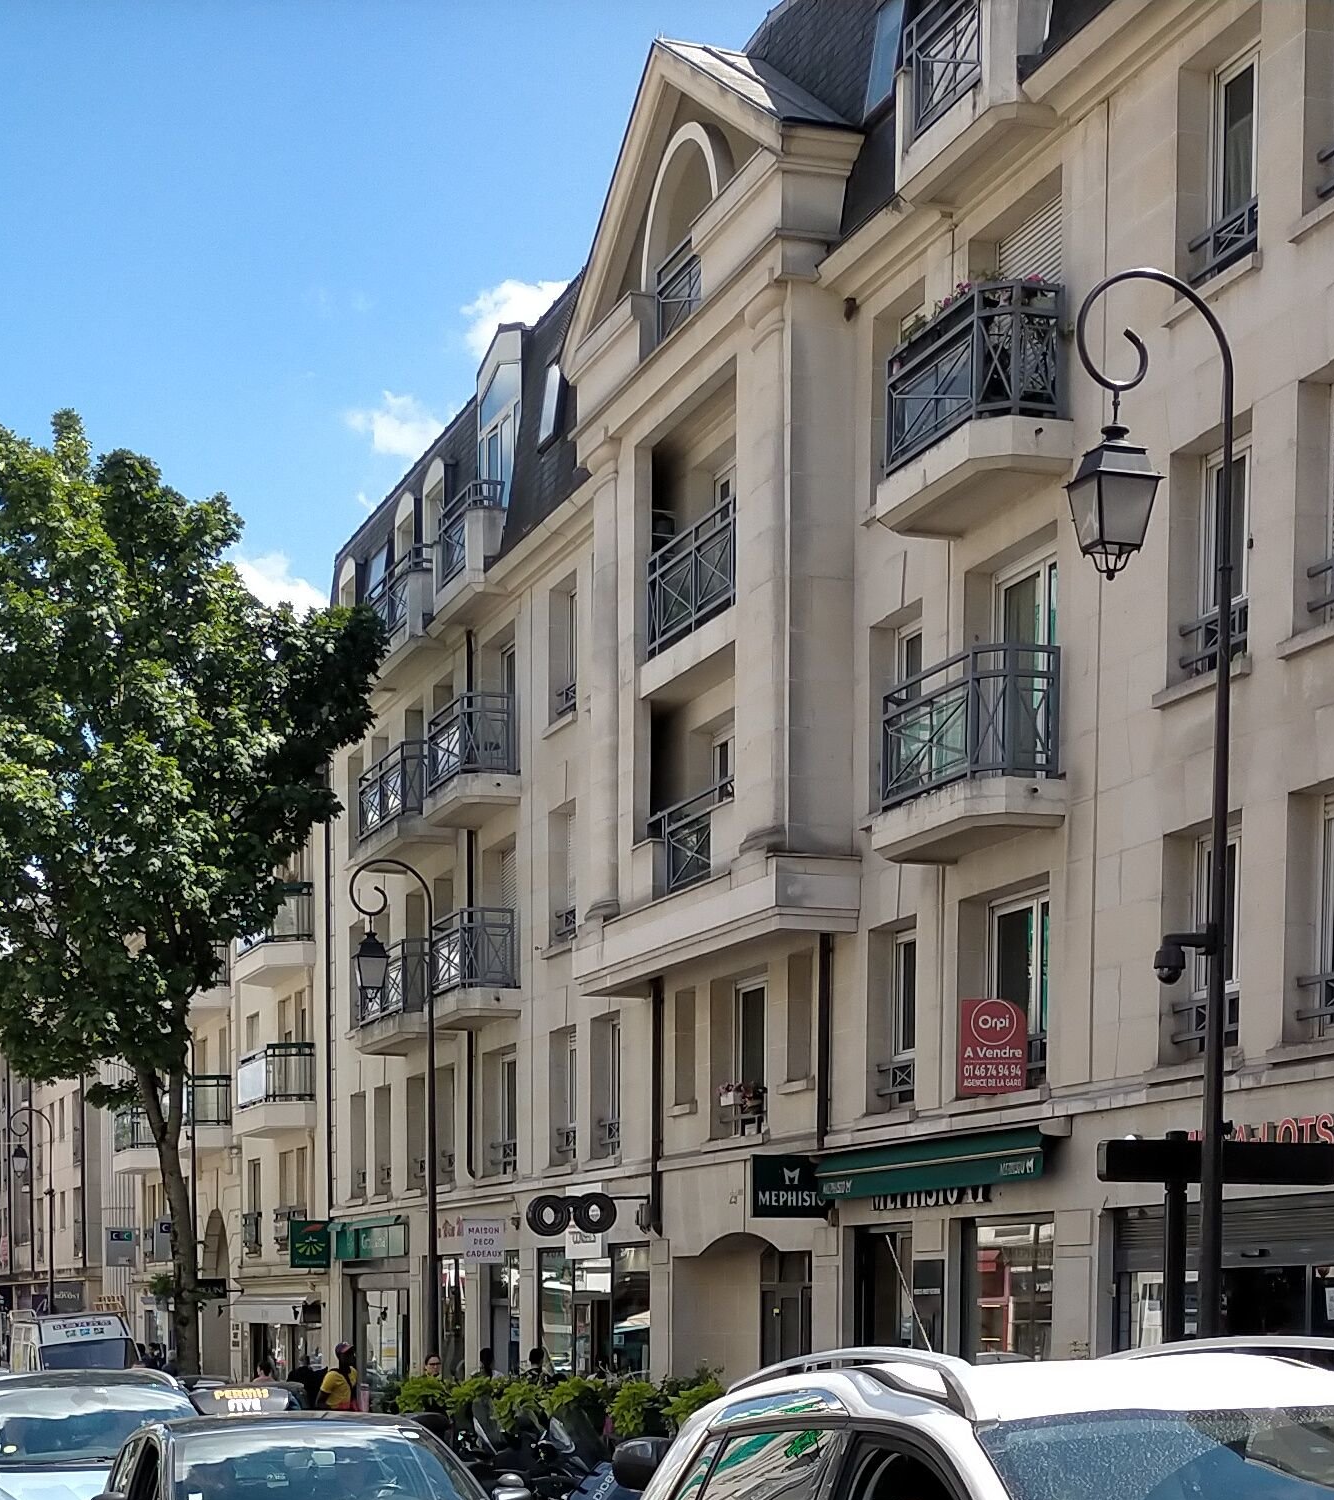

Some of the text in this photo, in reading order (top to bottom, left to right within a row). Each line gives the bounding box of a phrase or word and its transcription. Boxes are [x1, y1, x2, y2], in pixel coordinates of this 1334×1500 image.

[978, 1014, 1010, 1031] Orpi
[964, 1046, 1023, 1058] A Vendre
[963, 1064, 1022, 1077] 01 46 74 94 94
[468, 1226, 500, 1235] MAISON
[466, 1249, 503, 1258] CADEAUX
[214, 1388, 270, 1401] PERMIS
